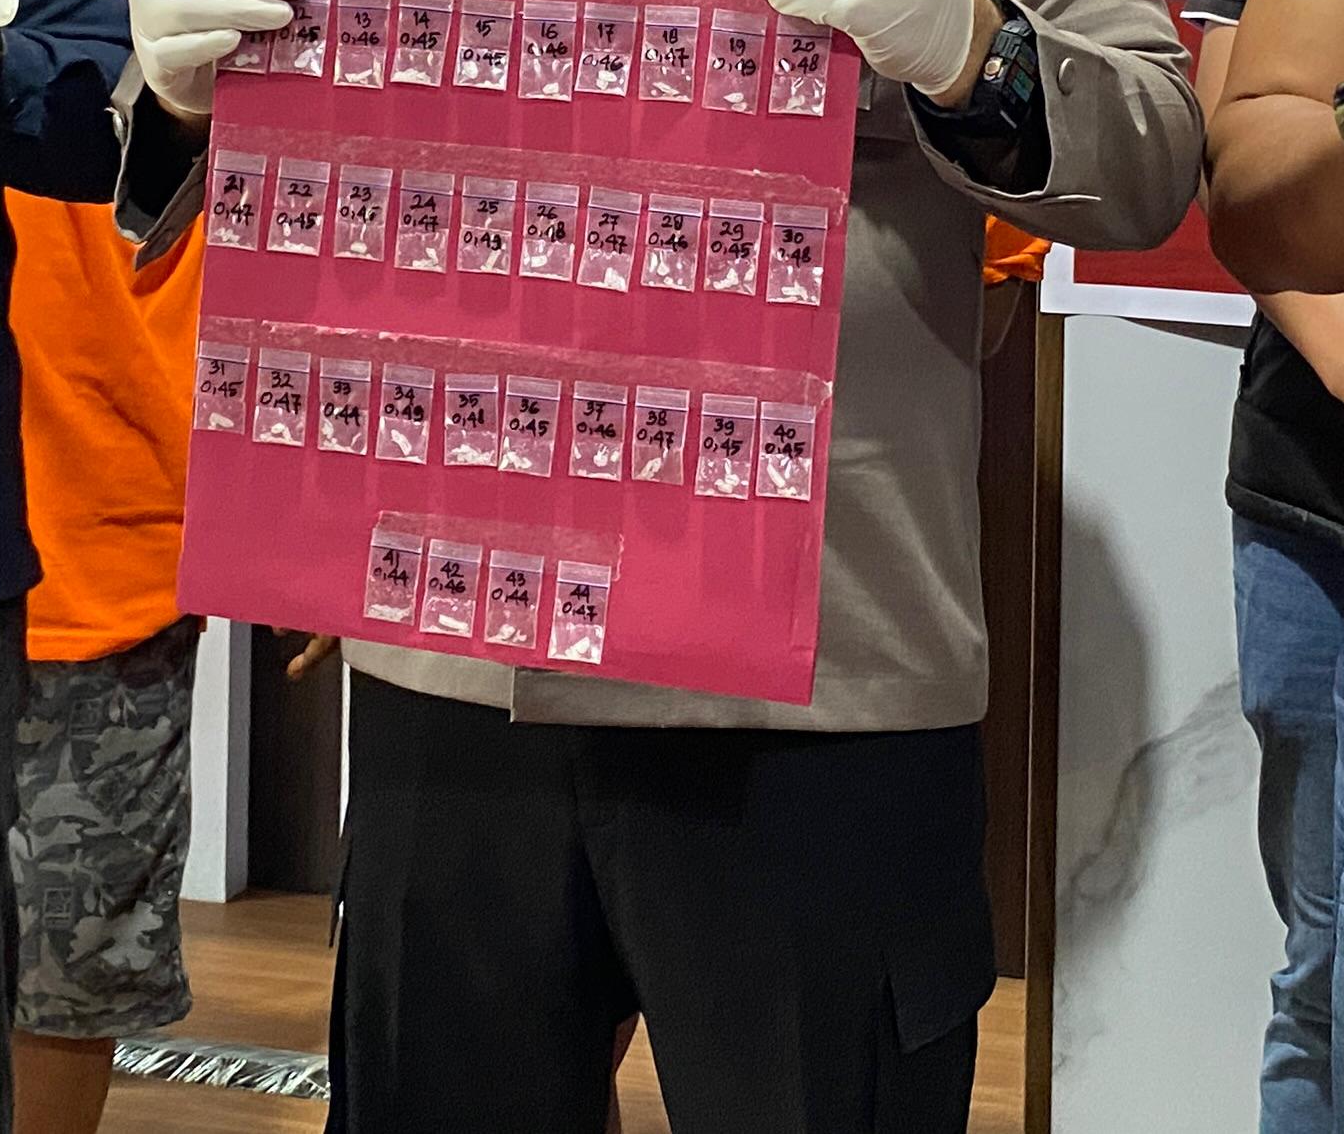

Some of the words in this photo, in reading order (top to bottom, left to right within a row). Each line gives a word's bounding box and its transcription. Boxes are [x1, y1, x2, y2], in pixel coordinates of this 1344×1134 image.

[355, 11, 371, 28] 13
[413, 11, 430, 29] 14
[541, 22, 559, 39] 16
[597, 22, 615, 43] 17
[662, 28, 678, 44] 18
[729, 38, 746, 56] 19
[792, 39, 816, 53] 20
[224, 175, 244, 194] 21
[288, 183, 313, 197] 22
[349, 186, 372, 202] 23
[409, 194, 436, 212] 24
[477, 200, 499, 214] 25
[537, 205, 558, 220] 26
[599, 214, 619, 232] 27
[661, 214, 684, 231] 28
[719, 222, 744, 241] 29
[782, 229, 804, 244] 30
[208, 360, 225, 375] 31
[271, 370, 294, 388] 32
[333, 381, 352, 395] 33
[393, 387, 416, 403] 34
[458, 394, 480, 408] 35
[519, 398, 540, 414] 36
[583, 402, 606, 421] 37
[646, 410, 668, 426] 38
[713, 418, 735, 435] 39
[773, 424, 796, 443] 40
[382, 549, 400, 568] 41
[440, 562, 465, 578] 42
[505, 571, 526, 587] 43
[570, 585, 591, 603] 44
